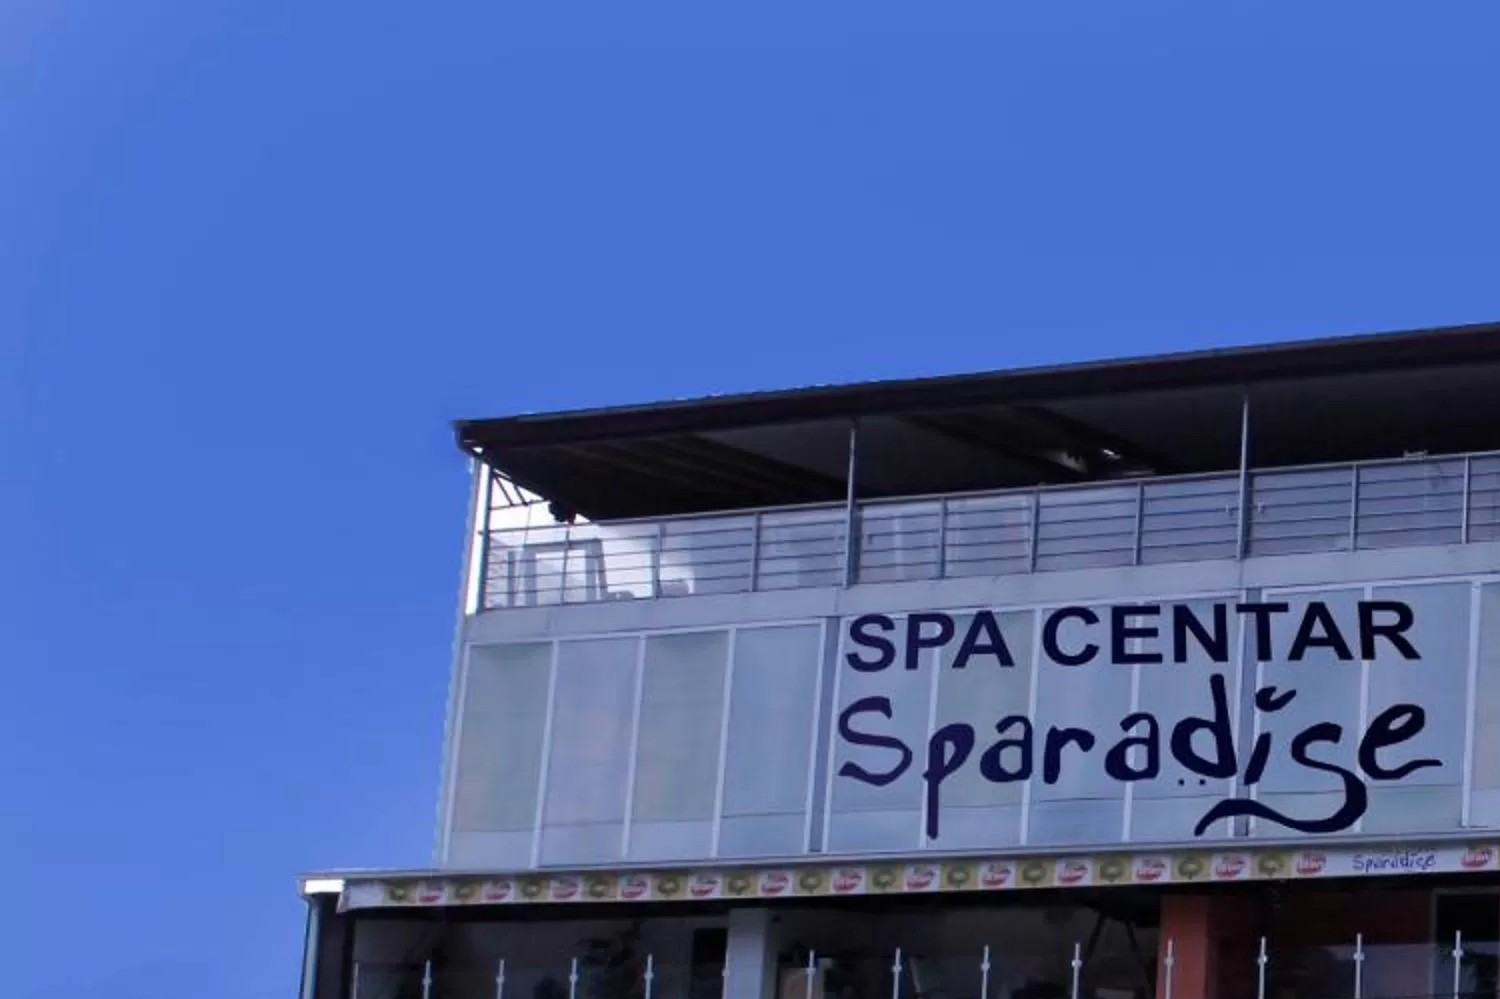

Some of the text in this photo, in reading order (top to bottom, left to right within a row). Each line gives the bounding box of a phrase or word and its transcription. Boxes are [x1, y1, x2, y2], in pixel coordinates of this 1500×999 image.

[845, 601, 1422, 672] SPA CENTAR
[838, 674, 1442, 840] Sparadise
